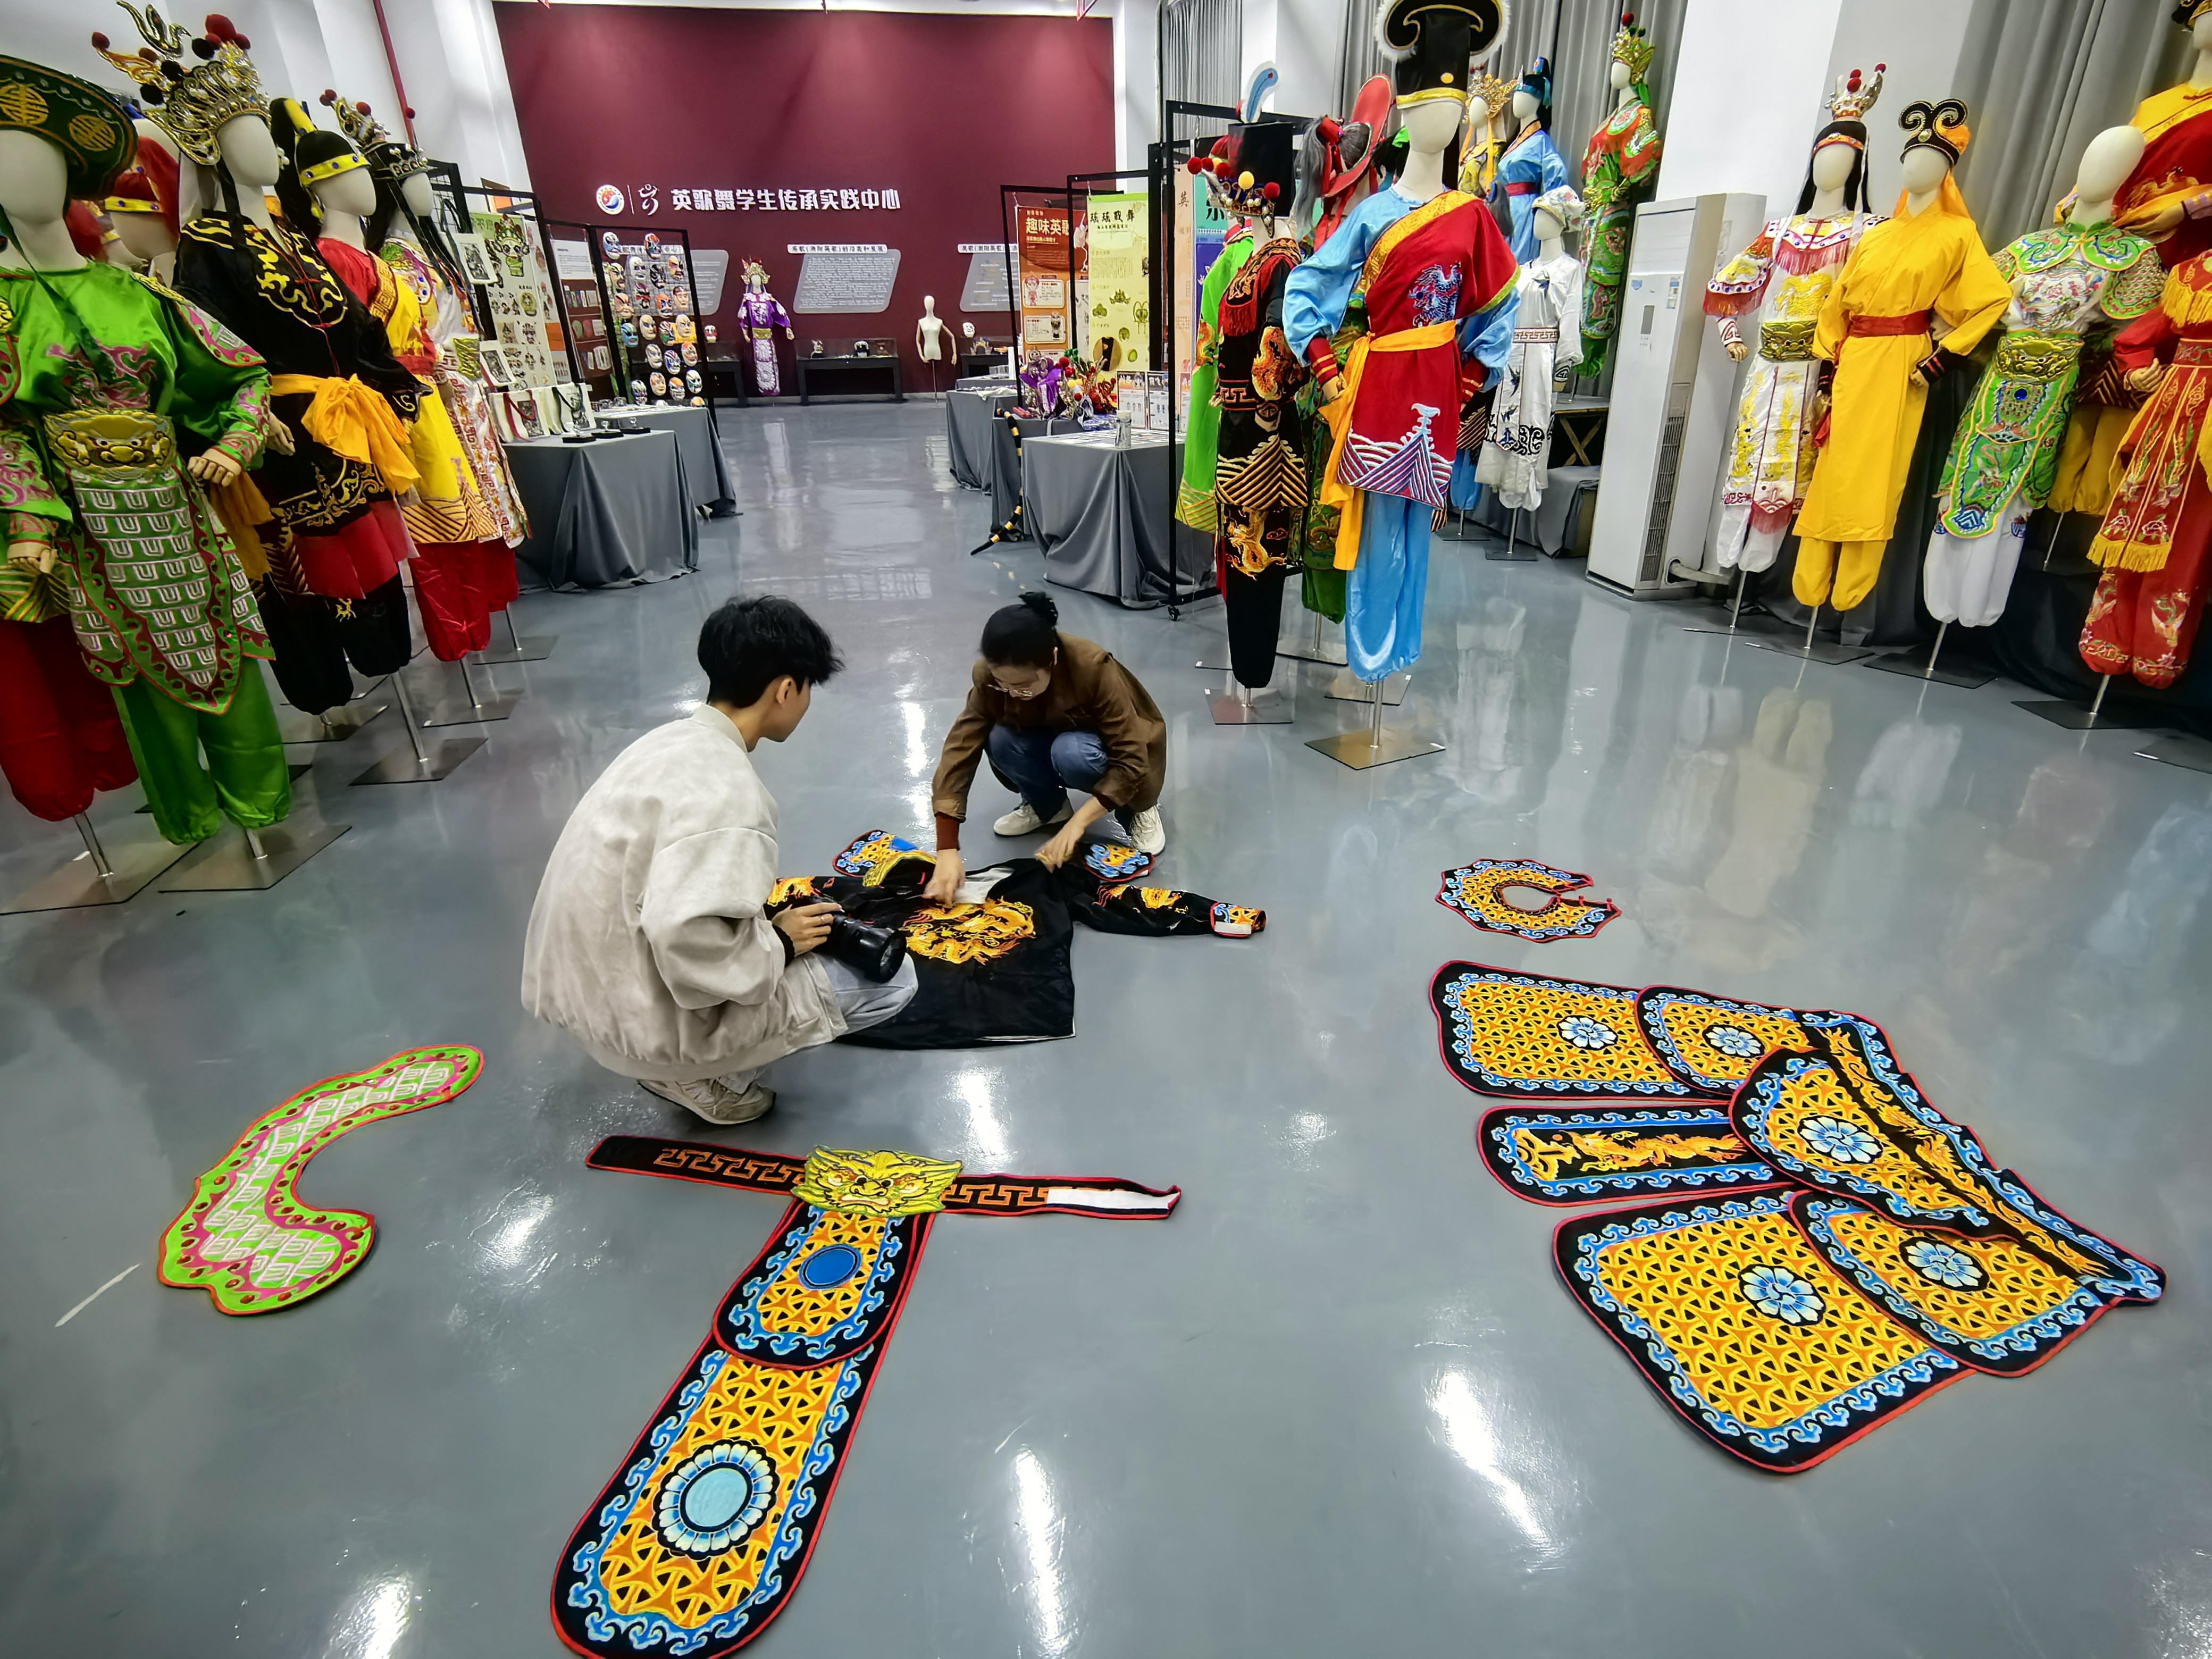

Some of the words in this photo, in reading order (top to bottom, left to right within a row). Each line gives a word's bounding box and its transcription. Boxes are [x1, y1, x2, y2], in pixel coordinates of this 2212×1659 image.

[671, 188, 901, 212] 英歌舞学生传承实践中心
